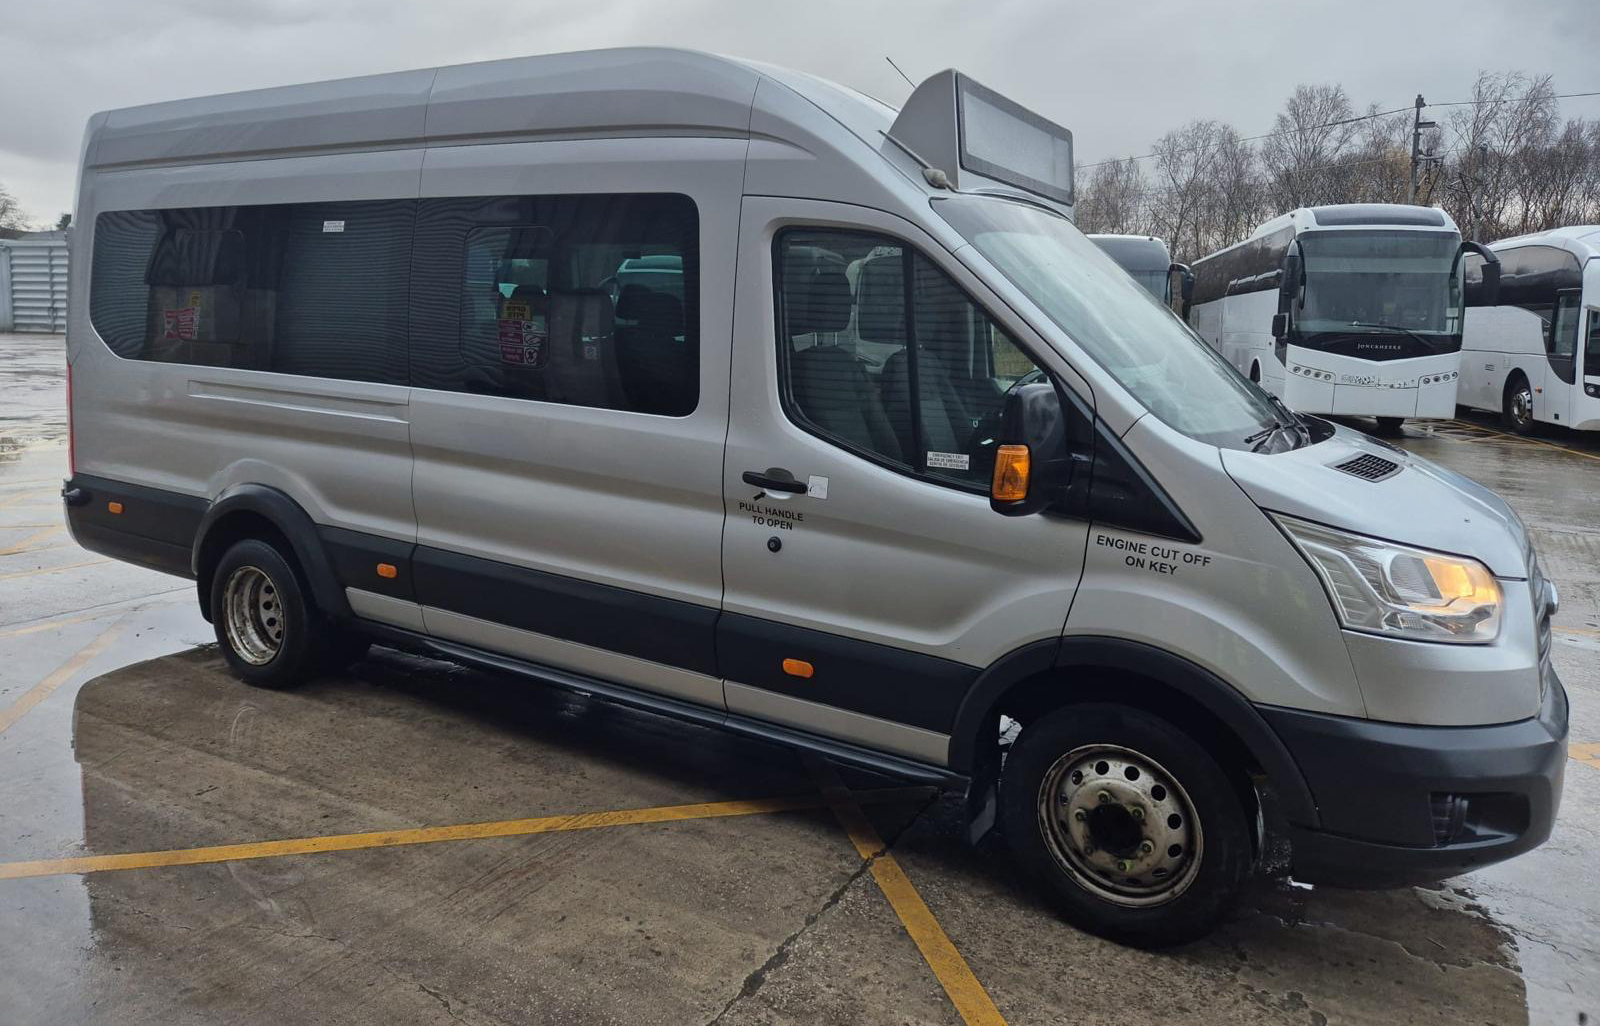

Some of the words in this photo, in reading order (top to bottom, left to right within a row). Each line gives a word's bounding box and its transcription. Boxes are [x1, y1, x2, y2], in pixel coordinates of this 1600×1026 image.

[739, 502, 763, 514] PULL
[765, 507, 804, 521] HANDLE
[752, 515, 765, 525] TO
[767, 518, 793, 530] OPEN
[1096, 534, 1147, 554] ENGINE
[1151, 546, 1180, 560] CUT
[1183, 552, 1211, 566] OFF
[1125, 555, 1145, 569] ON
[1149, 560, 1178, 575] KEY
